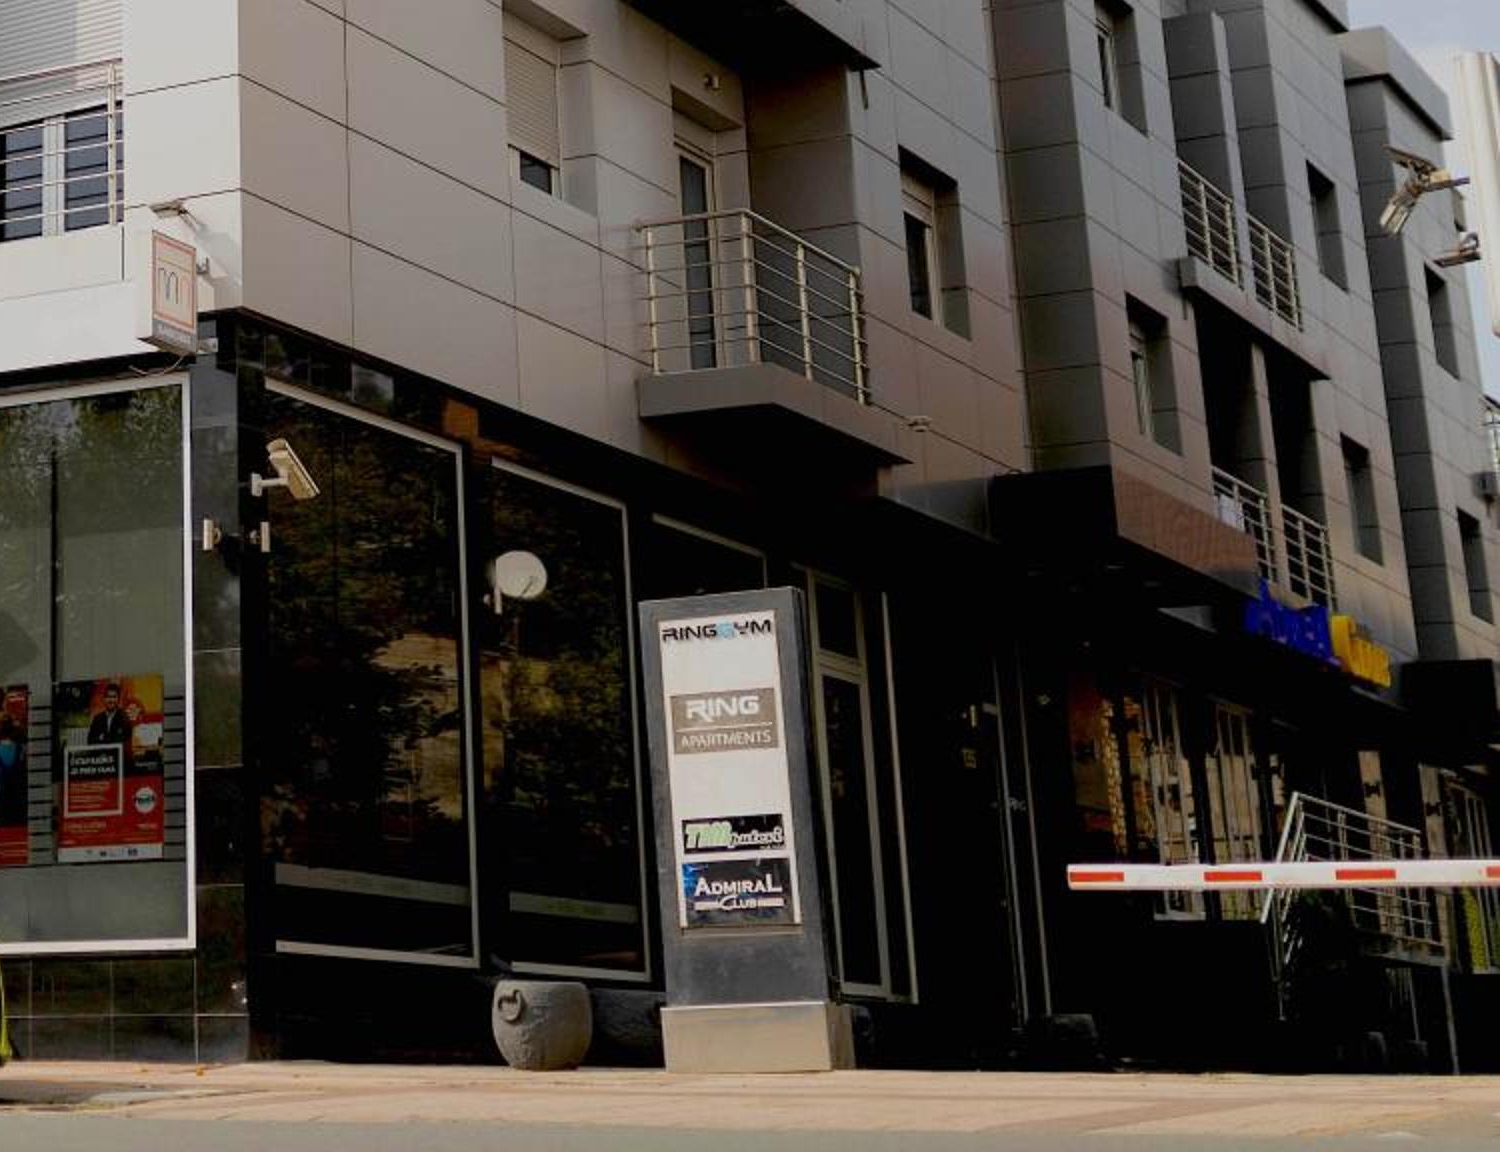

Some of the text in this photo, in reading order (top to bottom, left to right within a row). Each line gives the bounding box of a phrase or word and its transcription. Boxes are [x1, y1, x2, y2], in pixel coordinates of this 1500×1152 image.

[686, 695, 760, 723] RING
[681, 729, 772, 748] APARTMENTS
[694, 873, 783, 897] ADMIRAL
